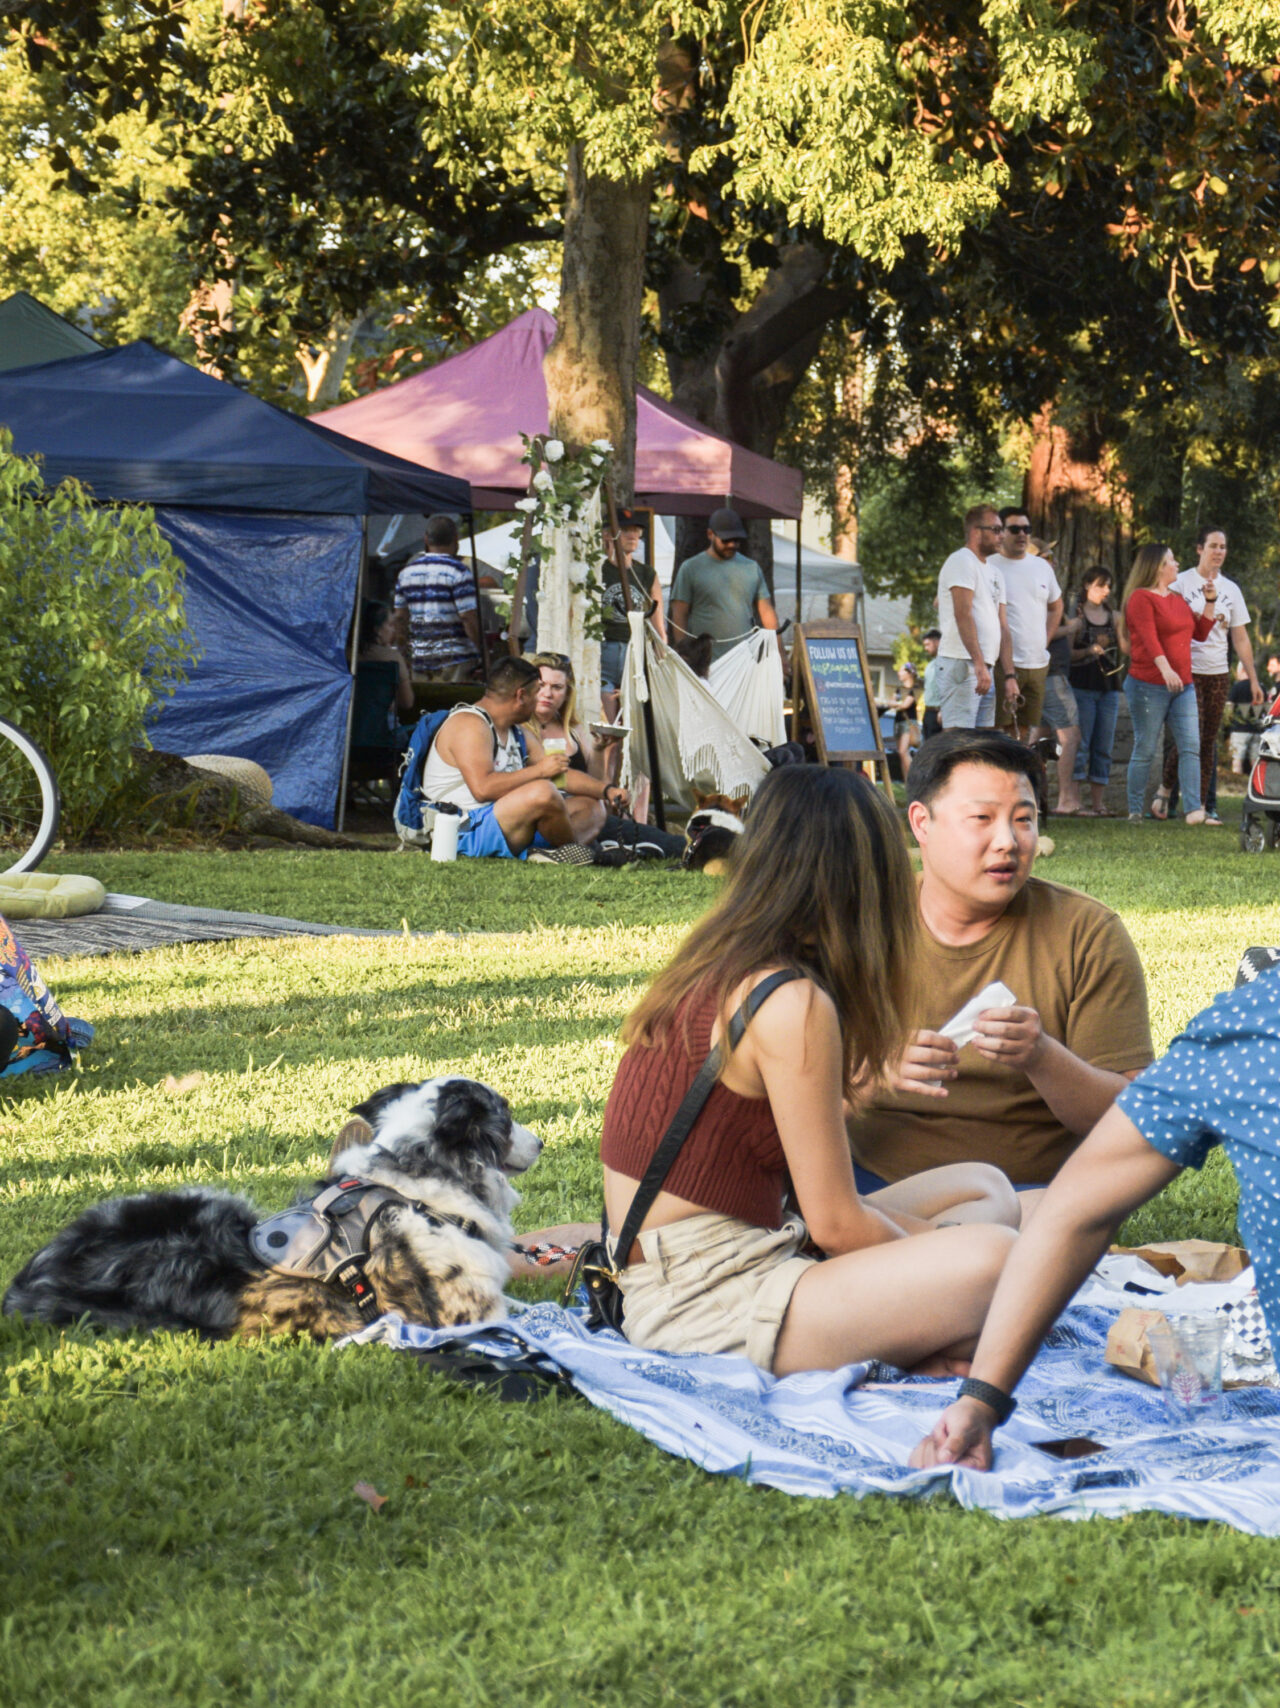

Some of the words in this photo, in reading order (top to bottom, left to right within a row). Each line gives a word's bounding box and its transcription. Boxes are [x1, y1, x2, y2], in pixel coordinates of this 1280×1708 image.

[809, 646, 836, 660] FOLLOW
[838, 647, 846, 660] US
[847, 647, 858, 660] ON
